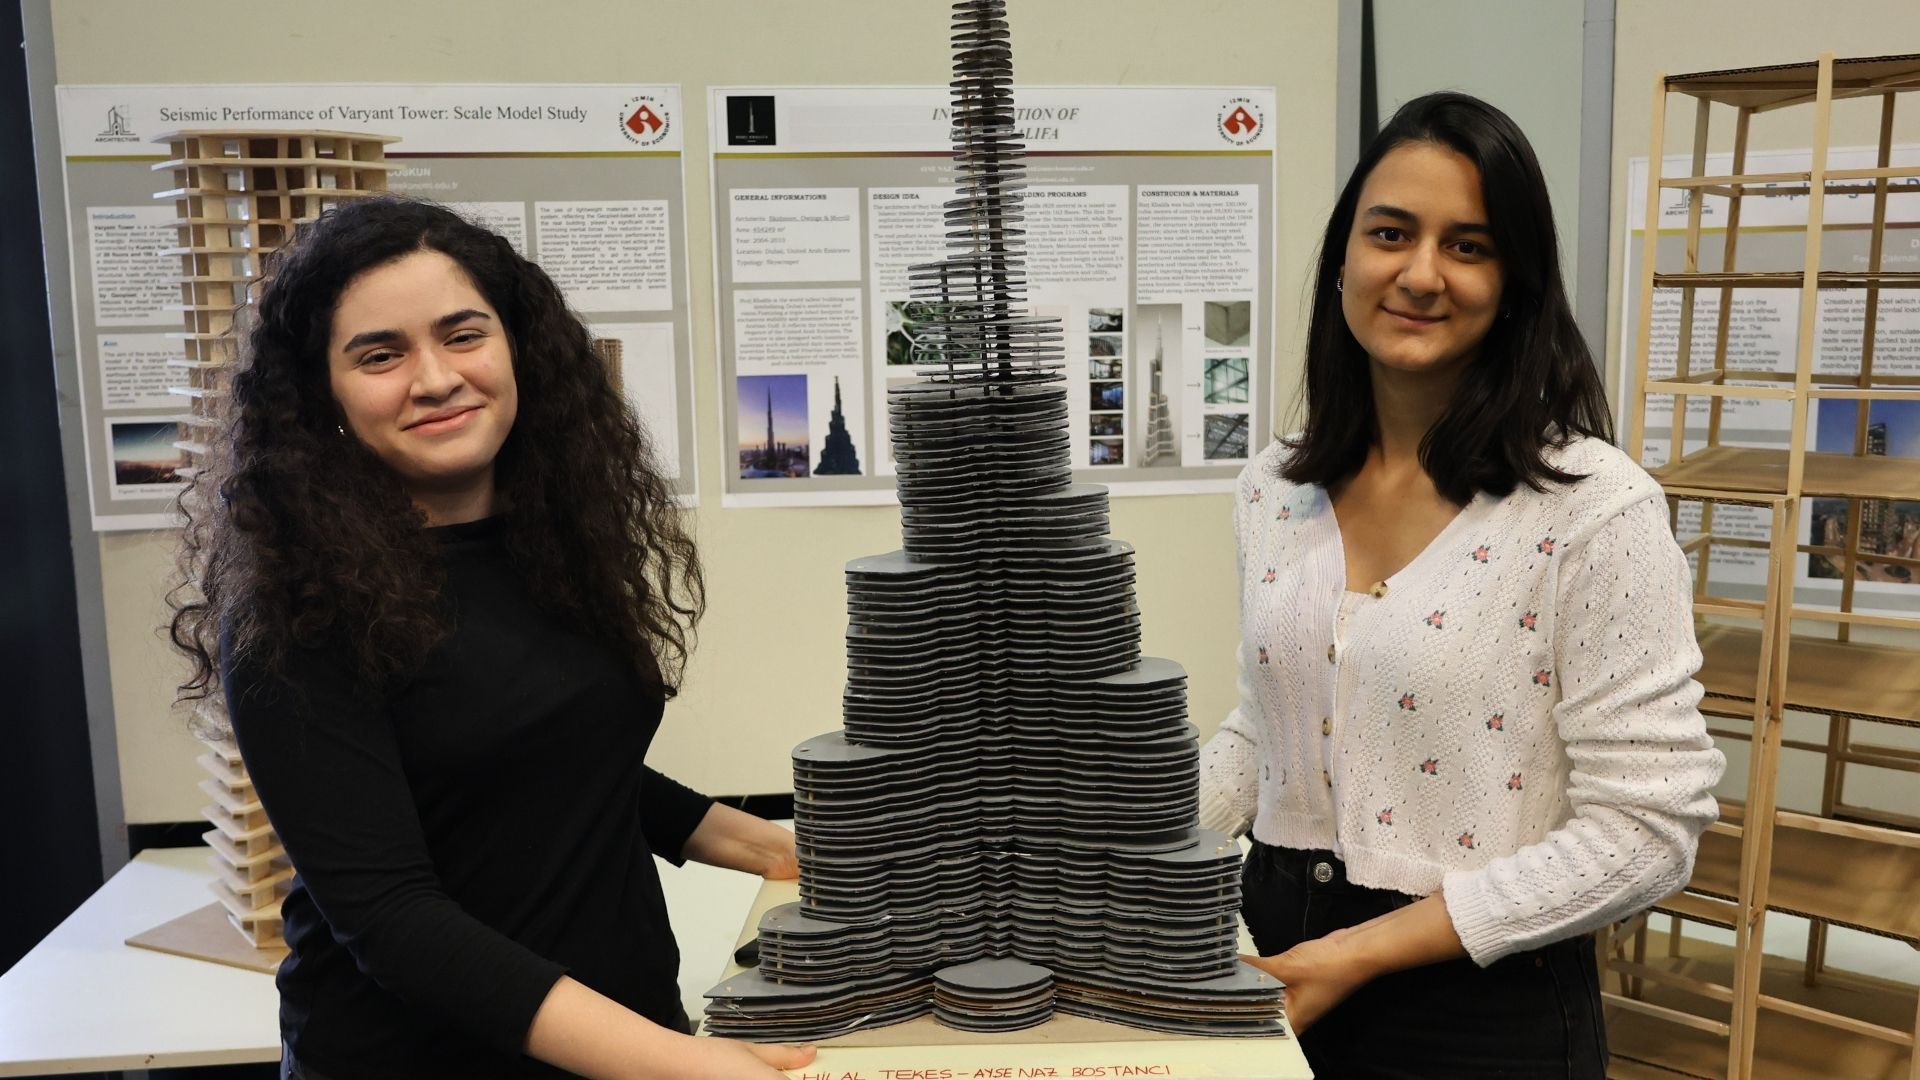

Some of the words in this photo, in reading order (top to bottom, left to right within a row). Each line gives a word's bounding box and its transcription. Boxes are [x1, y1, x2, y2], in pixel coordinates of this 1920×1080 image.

[160, 108, 218, 121] Seismic
[223, 107, 314, 121] Performance
[319, 106, 335, 120] of
[338, 107, 394, 123] Varyant
[398, 106, 449, 120] Tower:
[454, 106, 492, 120] Scale
[497, 106, 542, 120] Model
[548, 106, 588, 123] Study
[1058, 108, 1080, 120] OF
[1072, 1065, 1171, 1078] BOSTANCI
